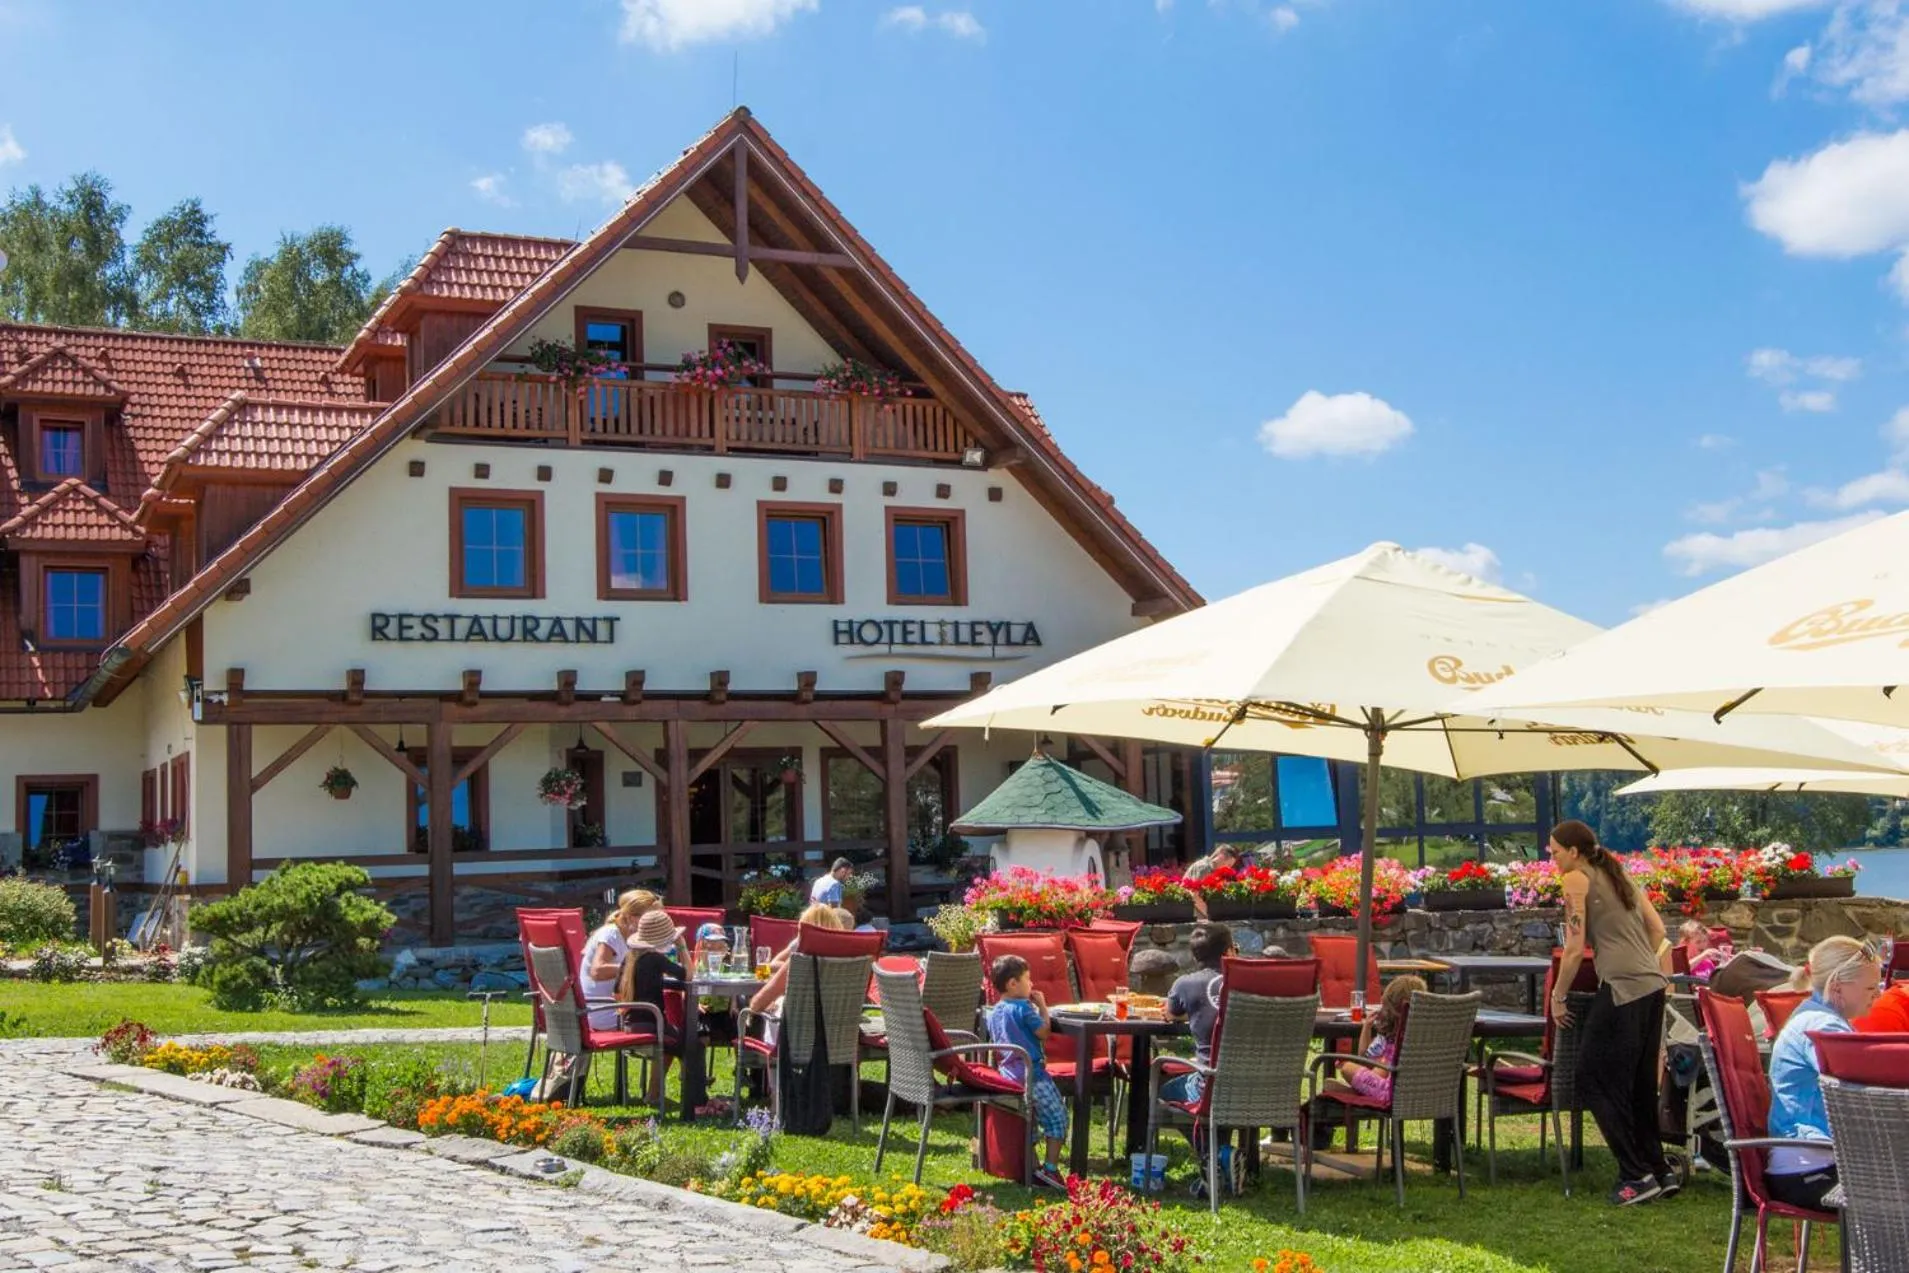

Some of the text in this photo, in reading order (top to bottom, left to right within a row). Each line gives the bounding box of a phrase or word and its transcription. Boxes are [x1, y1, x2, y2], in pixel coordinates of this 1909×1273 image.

[371, 613, 620, 643] RESTAURANT
[833, 619, 1042, 647] HOTEL LEYLA
